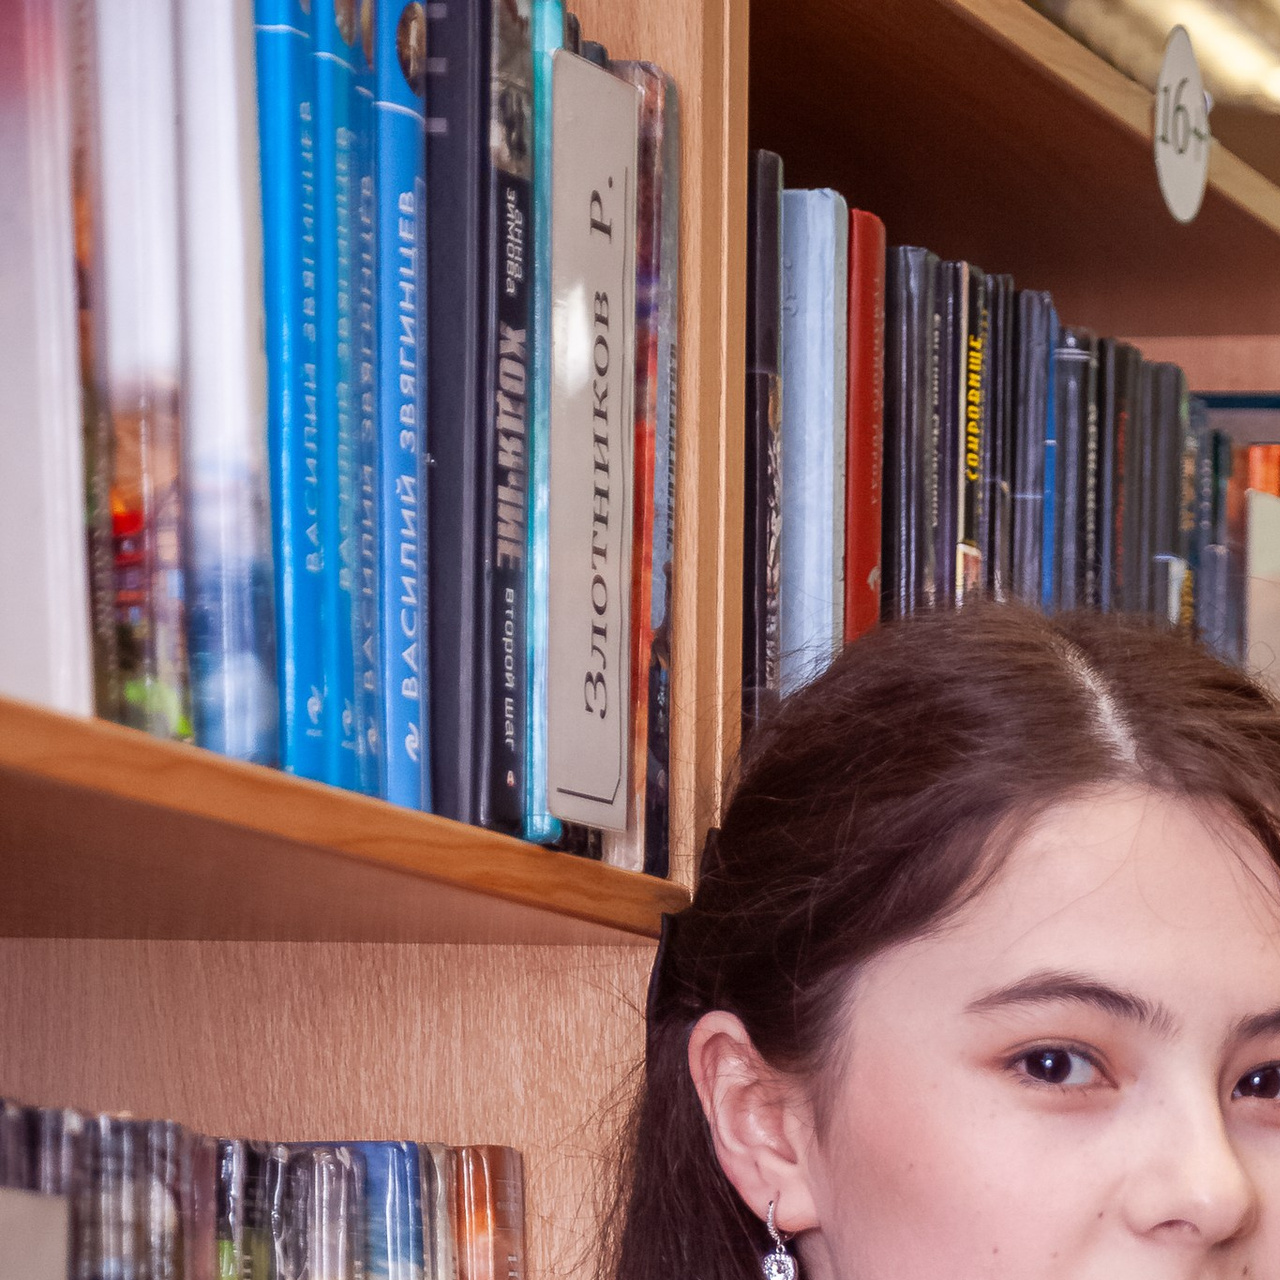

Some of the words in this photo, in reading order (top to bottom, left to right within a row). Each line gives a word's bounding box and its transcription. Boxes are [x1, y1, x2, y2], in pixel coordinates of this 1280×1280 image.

[504, 186, 518, 298] зимова
[588, 174, 615, 237] Р.
[396, 189, 418, 451] ЗВЯГИНЦЕВ
[303, 360, 325, 573] ВАСИЛИЙ
[495, 320, 528, 571] ХОДЯЧИЕ
[581, 289, 611, 720] Злотников
[358, 463, 376, 692] ВАСИЛИЙ
[396, 471, 420, 701] ВАСИЛИЙ
[501, 585, 517, 690] второй
[502, 696, 517, 753] шаг
